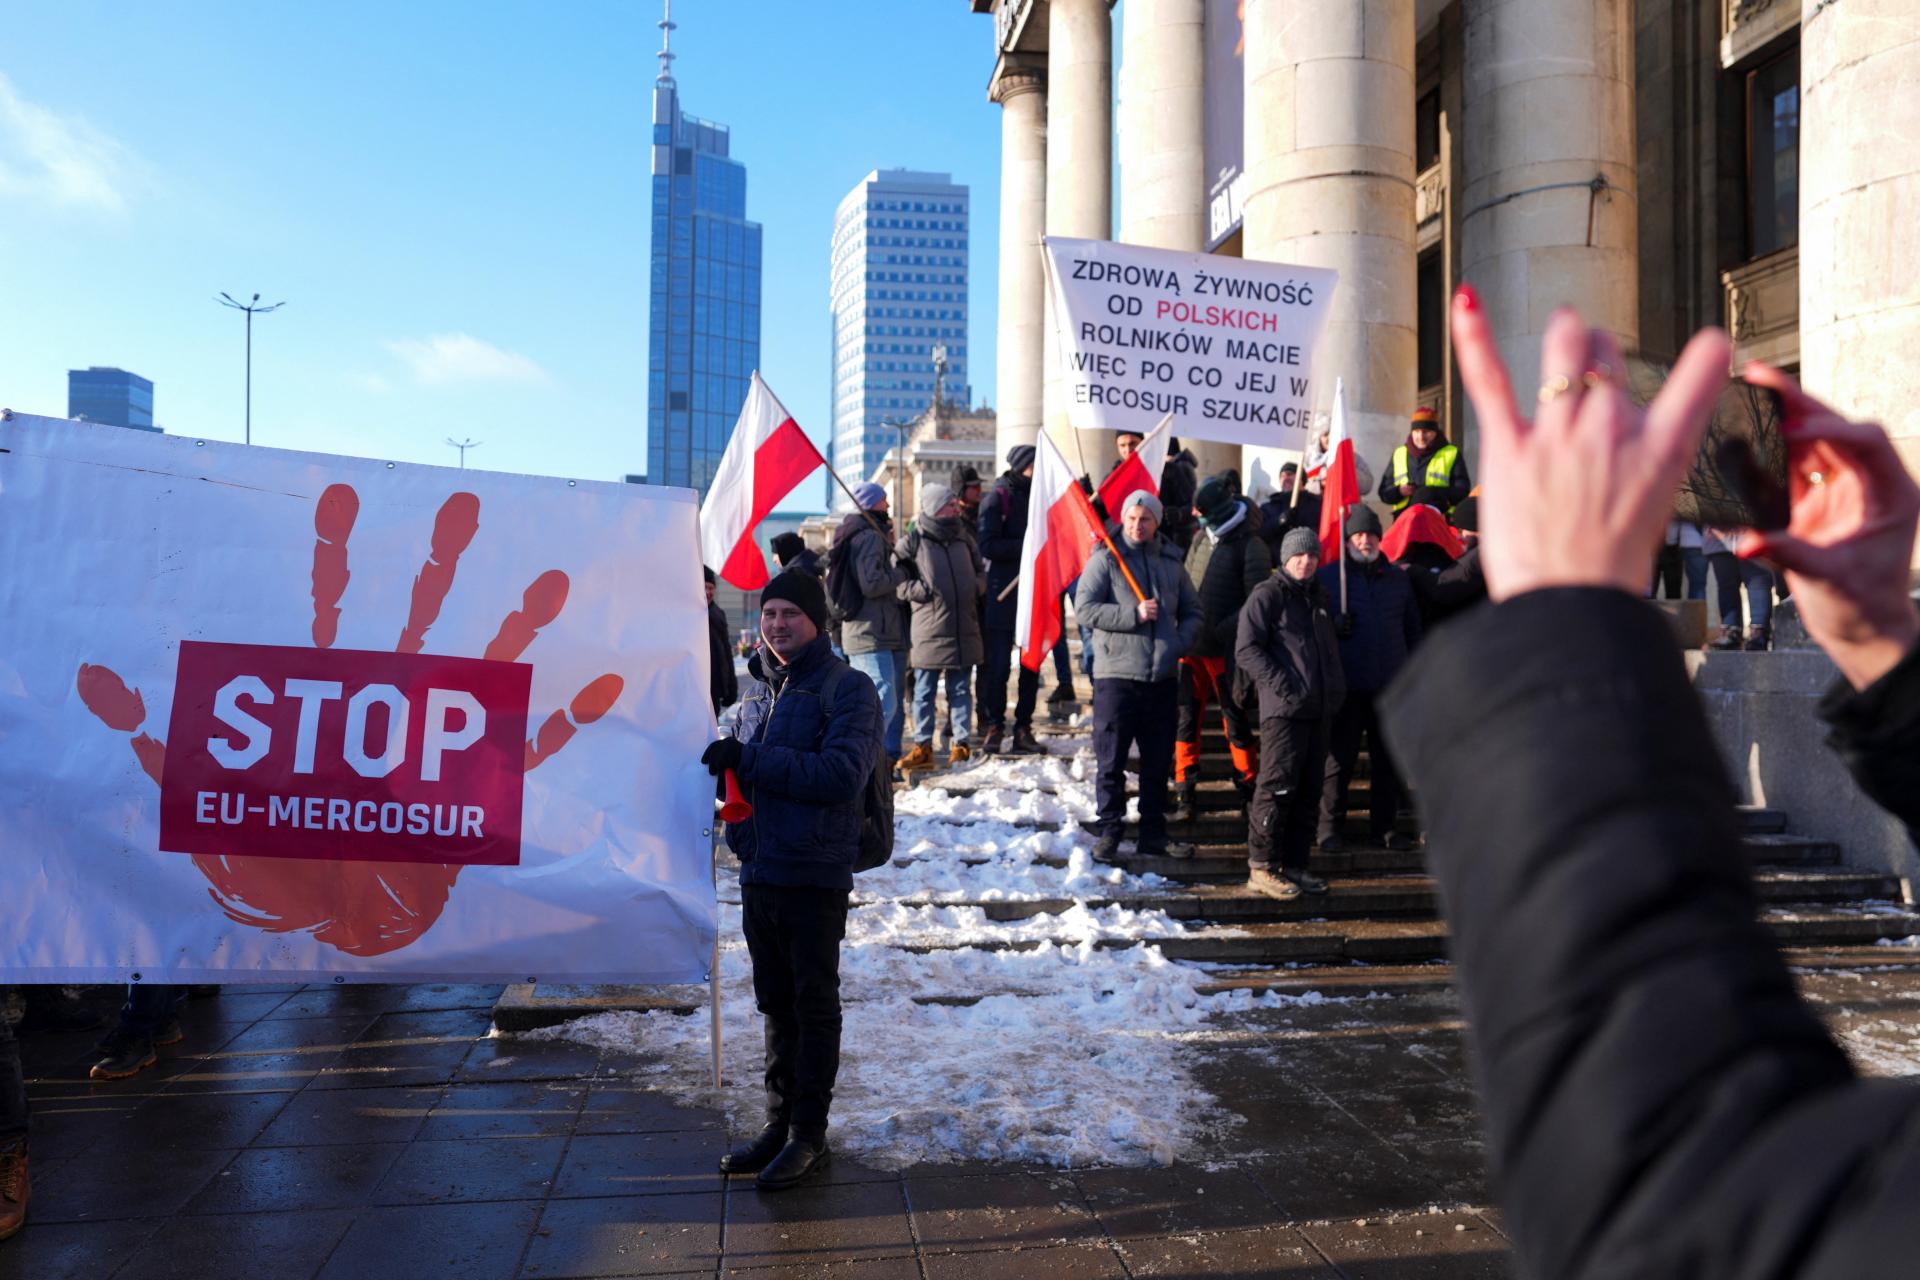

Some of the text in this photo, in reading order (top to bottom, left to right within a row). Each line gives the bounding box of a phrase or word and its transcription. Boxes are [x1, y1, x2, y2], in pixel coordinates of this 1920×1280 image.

[1072, 259, 1313, 306] ZDROWĄ ŻYWNOŚĆ
[1107, 294, 1278, 332] OD POLSKICH
[1081, 322, 1300, 366] ROLNIKÓW MACIE
[1069, 352, 1309, 397] WIĘC PO CO JEJ W
[1075, 384, 1311, 429] ERCOSUR SZUKACIE
[206, 674, 487, 782] STOP
[196, 790, 485, 838] EU-MERCOSUR
